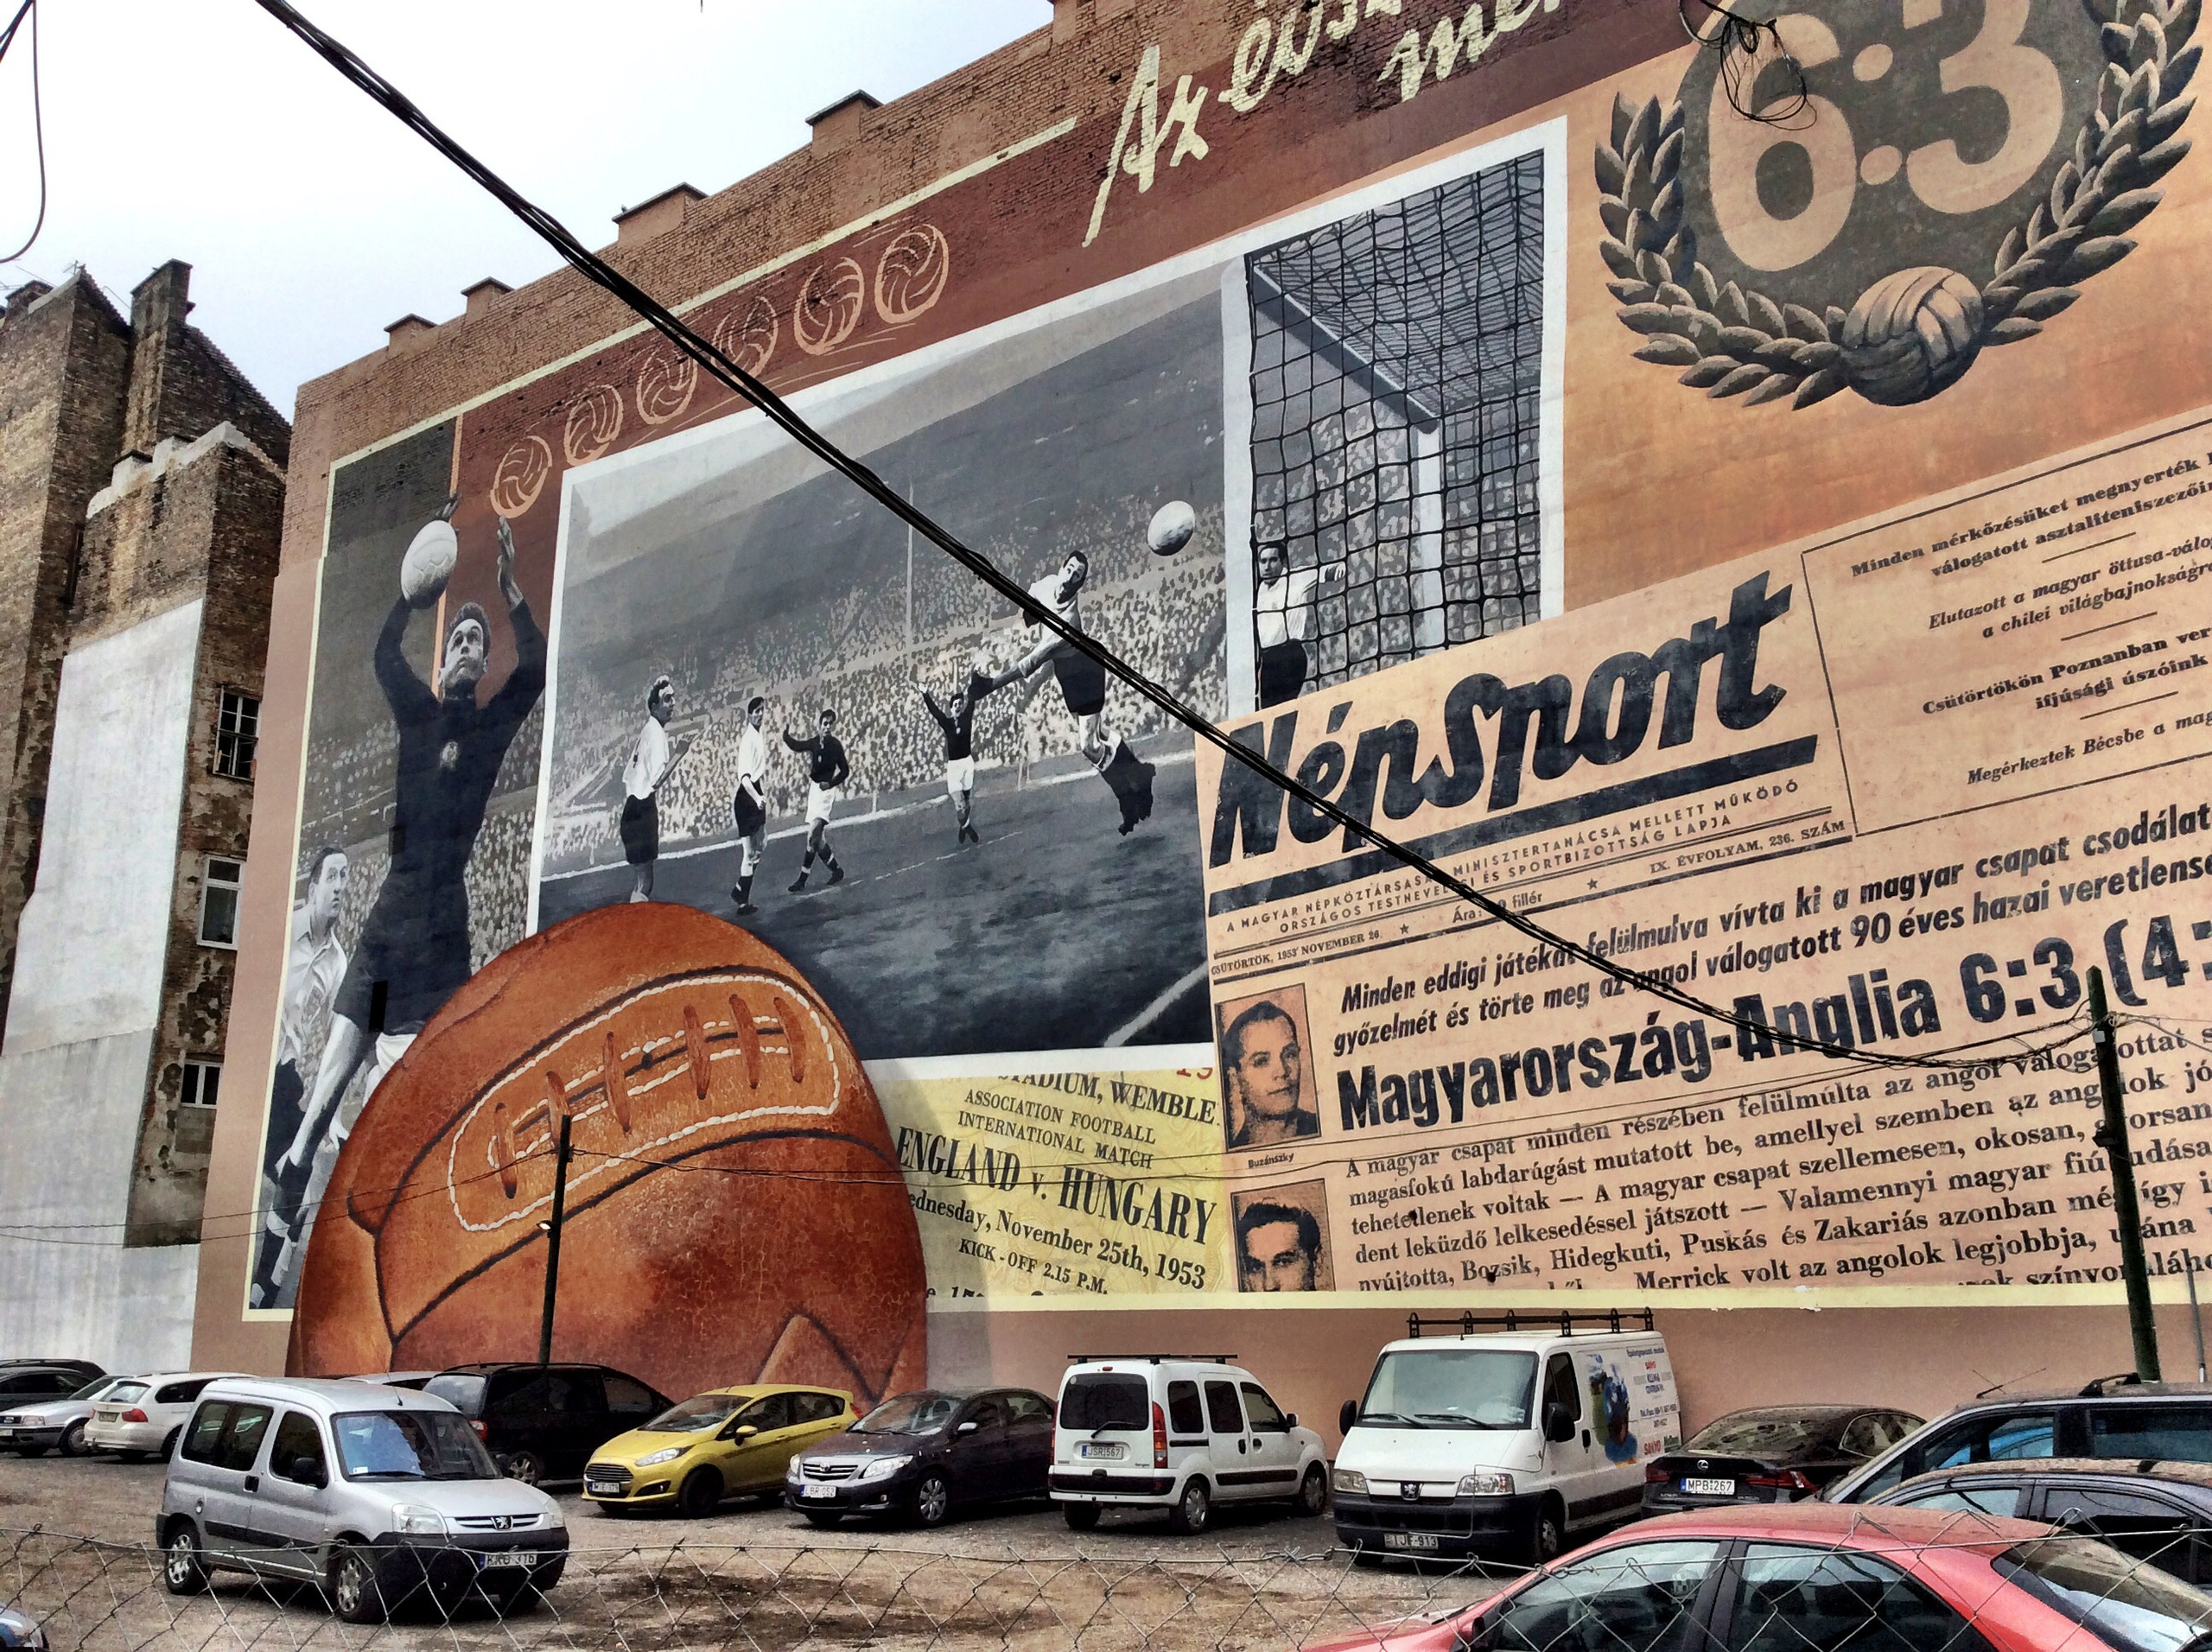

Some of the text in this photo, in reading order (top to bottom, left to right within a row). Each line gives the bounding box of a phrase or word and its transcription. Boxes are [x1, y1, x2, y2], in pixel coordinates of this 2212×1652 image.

[1708, 0, 2063, 271] 6:3
[1851, 459, 2202, 577] Minden mérkőzésüket megnyerték
[1931, 537, 2029, 577] válogatott
[1929, 595, 2006, 630] Elutazott
[2013, 593, 2025, 605] a
[2033, 569, 2101, 600] magyar
[1982, 626, 1994, 639] a
[2001, 610, 2050, 632] chilei
[1923, 672, 2044, 715] Csütörtökön
[2049, 639, 2169, 680] Poznanban
[2035, 653, 2209, 709] ifjúsági úszóink
[1967, 745, 2076, 785] Megérkeztek
[2082, 728, 2145, 754] Bécsbe
[2153, 722, 2166, 735] a
[1227, 920, 1235, 933] A
[1241, 906, 1299, 929] MAGYAR
[1452, 825, 1622, 877] MINISZTERTANÁCSA
[1630, 804, 1705, 832] MELLETT
[1279, 905, 1363, 934] ORSZÁGOS
[1483, 867, 1500, 884] ÉS
[1509, 828, 1665, 877] SPORTBIZOTTSÁG
[1675, 814, 1732, 837] LAPJA
[1649, 820, 1846, 874] IX. ÉVFOLYAM, 236. SZÁM
[1300, 933, 1365, 954] NOVEMBER
[1340, 975, 1416, 1014] Minden
[1423, 956, 1487, 994] eddigi
[1719, 899, 1785, 933] vívta
[1796, 885, 1821, 918] ki
[1833, 887, 1849, 910] a
[1859, 861, 1965, 904] magyar
[1975, 836, 2070, 880] csapat
[1452, 901, 1483, 924] Ára:
[1512, 892, 1543, 909] fillér
[1333, 1012, 1438, 1058] győzelmét
[1446, 1001, 1470, 1030] és
[1478, 993, 1535, 1022] törte
[1543, 982, 1591, 1010] meg
[1599, 976, 1624, 1000] az
[1706, 924, 1841, 975] válogatott
[1850, 912, 1891, 948] 90
[1898, 903, 1965, 938] éves
[1973, 880, 2050, 925] hazai
[1959, 936, 2082, 1024] 6:3
[958, 1110, 1154, 1170] INTERNATIONAL MATCH
[964, 1089, 1156, 1145] ASSOCIATION FOOTBALL
[1109, 1079, 1219, 1127] WEMBLE
[1346, 1158, 1361, 1178] A
[1367, 1149, 1440, 1176] magyar
[1451, 1136, 1516, 1163] csapat
[1527, 1123, 1611, 1151] minden
[1622, 1108, 1725, 1136] részében
[1738, 1082, 1872, 1118] felülmúlta
[1885, 1077, 1914, 1096] az
[897, 1126, 1020, 1192] ENGLAND
[1058, 1166, 1217, 1245] HUNGARY
[1248, 1152, 1295, 1169] Buzánszky
[1350, 1173, 1456, 1208] magasfokú
[1461, 1154, 1587, 1190] labdarúgást
[1594, 1140, 1693, 1171] mutatott
[1705, 1134, 1743, 1157] be,
[1754, 1112, 1865, 1148] amellyel
[1875, 1098, 1994, 1131] szemben
[2008, 1093, 2039, 1113] az
[1351, 1199, 1477, 1236] tehetetlenek
[1483, 1190, 1551, 1217] voltak
[1594, 1184, 1612, 1204] A
[1620, 1173, 1707, 1202] magyar
[1713, 1159, 1791, 1190] csapat
[1799, 1137, 1967, 1177] szellemesen,
[1974, 1123, 2086, 1152] okosan,
[909, 1189, 1206, 1290] ednesday, November 25th, 1953
[1355, 1242, 1400, 1264] dent
[1405, 1229, 1488, 1258] leküzdő
[1494, 1209, 1637, 1248] lelkesedéssel
[1644, 1200, 1731, 1236] játszott
[1777, 1169, 1938, 1212] Valamennyi
[1948, 1162, 2052, 1193] magyar
[2063, 1150, 2106, 1176] fiú
[1461, 1254, 1541, 1283] Bozsik,
[1550, 1237, 1671, 1272] Hidegkuti,
[1680, 1229, 1768, 1256] Puskás
[1781, 1224, 1807, 1246] és
[1814, 1208, 1929, 1242] Zakariás
[1938, 1196, 2057, 1227] azonban
[1043, 1262, 1071, 1284] 2.15
[1076, 1271, 1108, 1295] P.M.
[1634, 1262, 1731, 1290] Merrick
[1741, 1258, 1792, 1283] volt
[1799, 1260, 1827, 1278] az
[1836, 1242, 1946, 1278] angolok
[1953, 1226, 2098, 1267] legjobbja,
